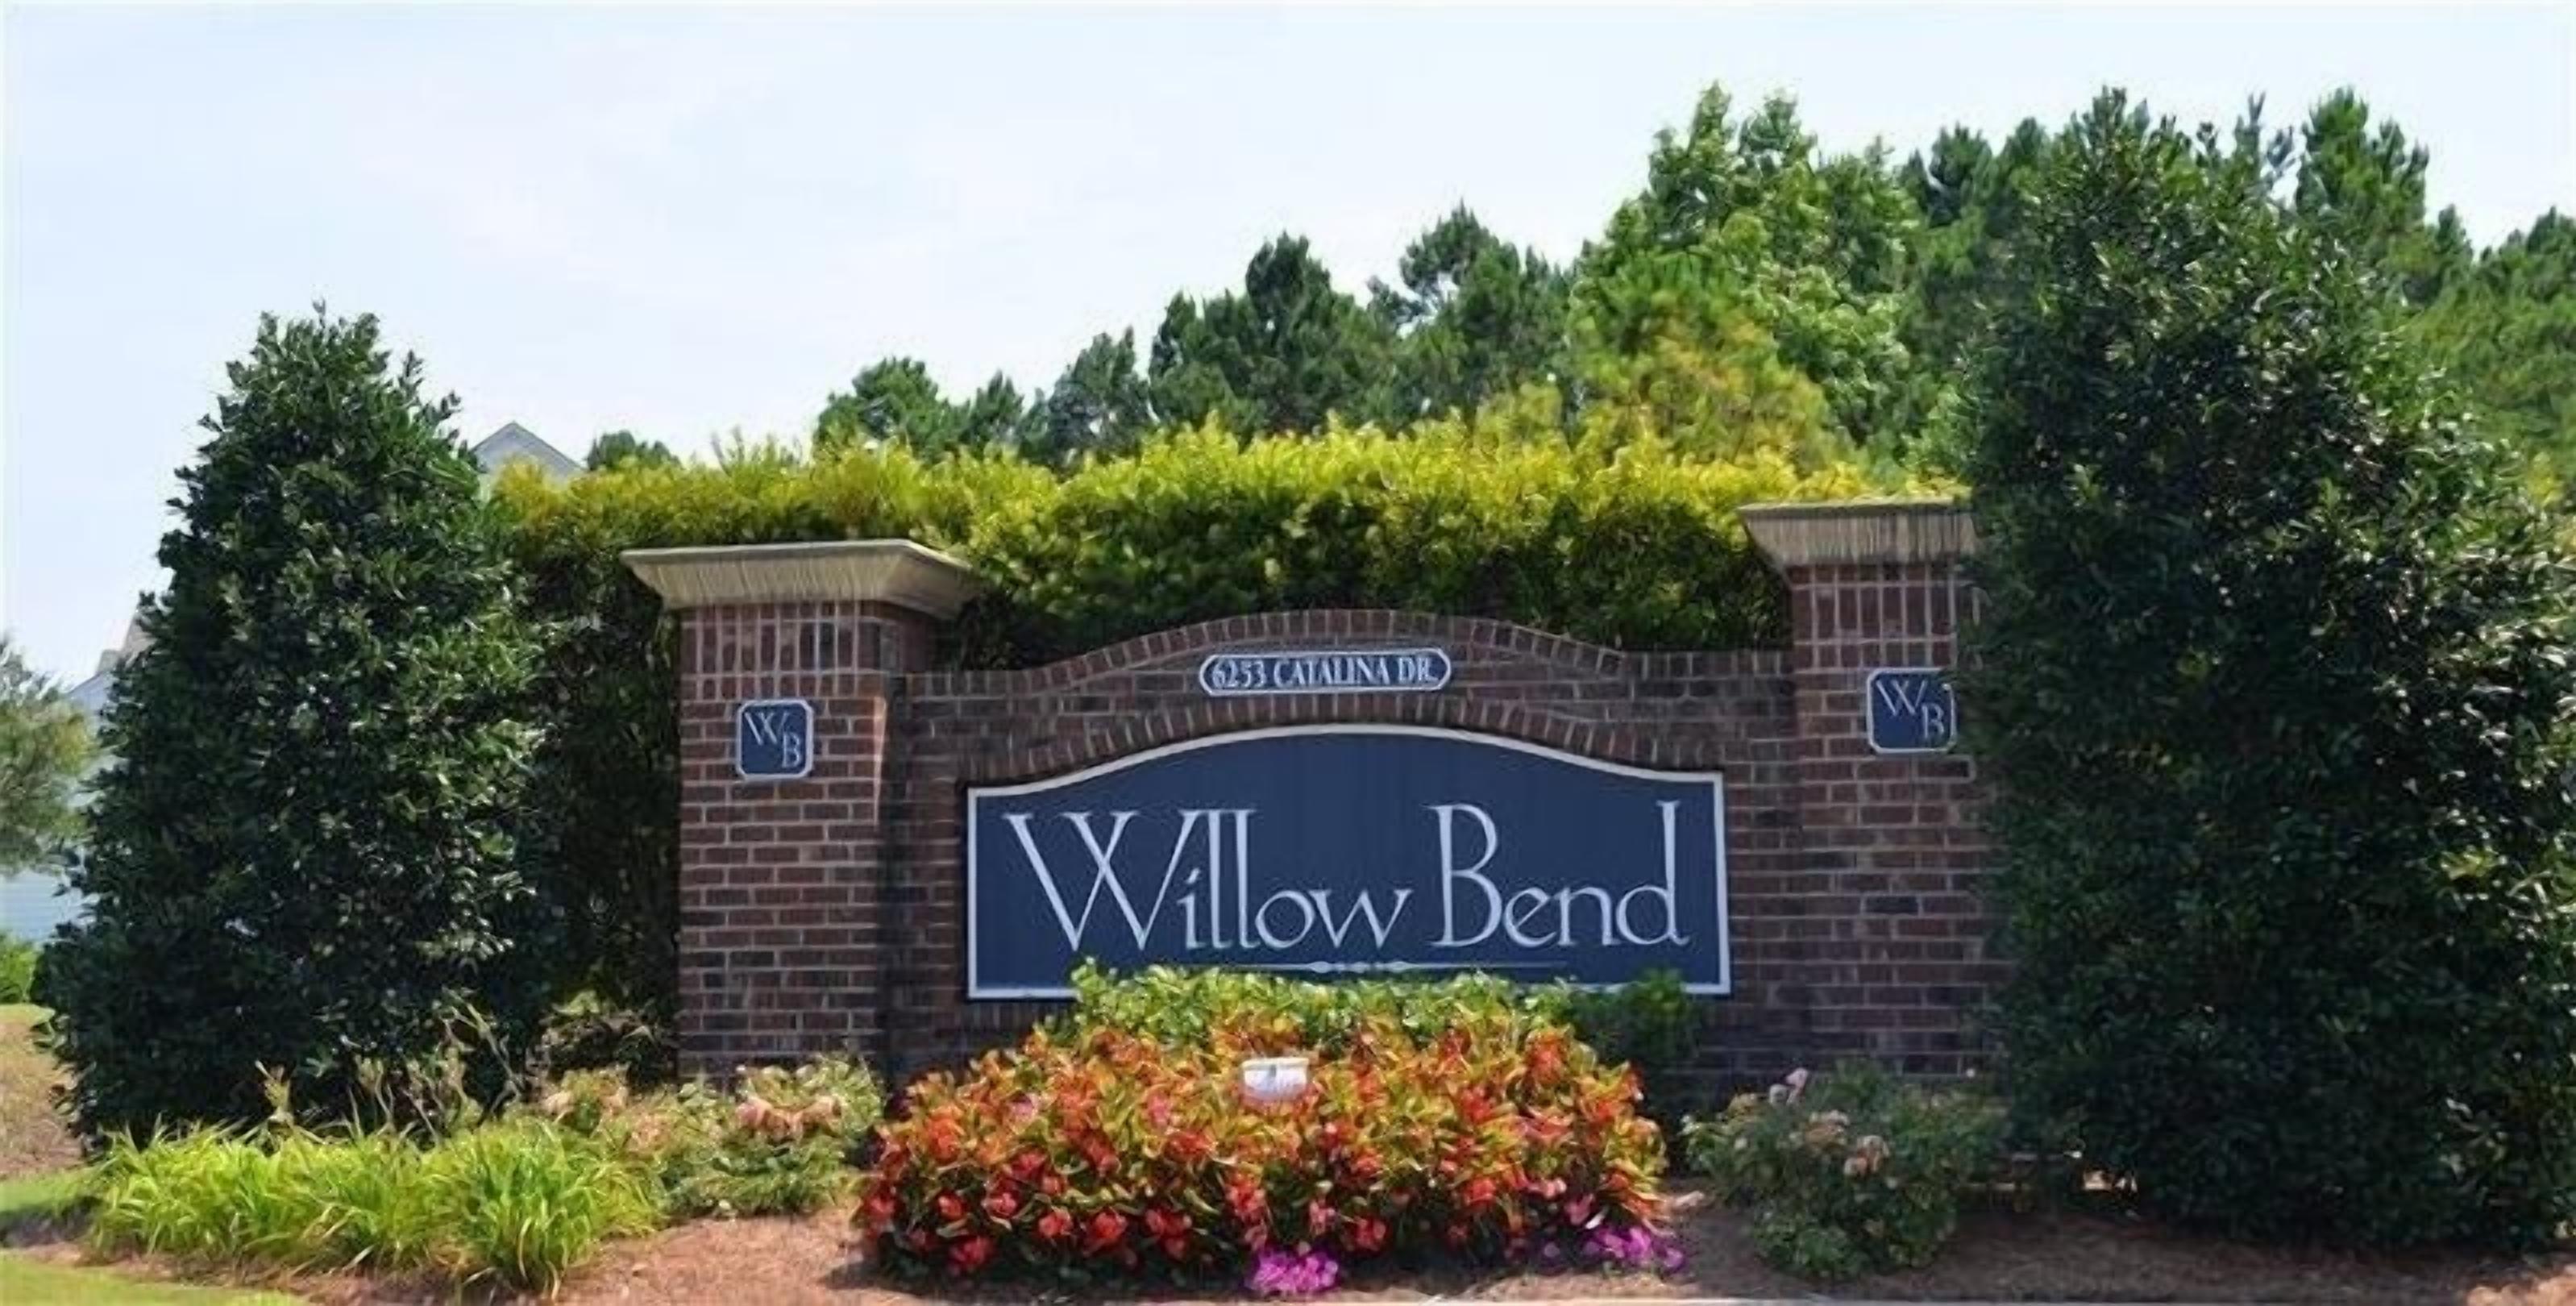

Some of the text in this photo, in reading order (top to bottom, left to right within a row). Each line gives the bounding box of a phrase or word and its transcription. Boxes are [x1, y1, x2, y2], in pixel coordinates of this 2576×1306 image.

[1211, 659, 1267, 688] 6253
[1273, 656, 1390, 686] CATALINA
[1003, 801, 1689, 951] Willow Bend
